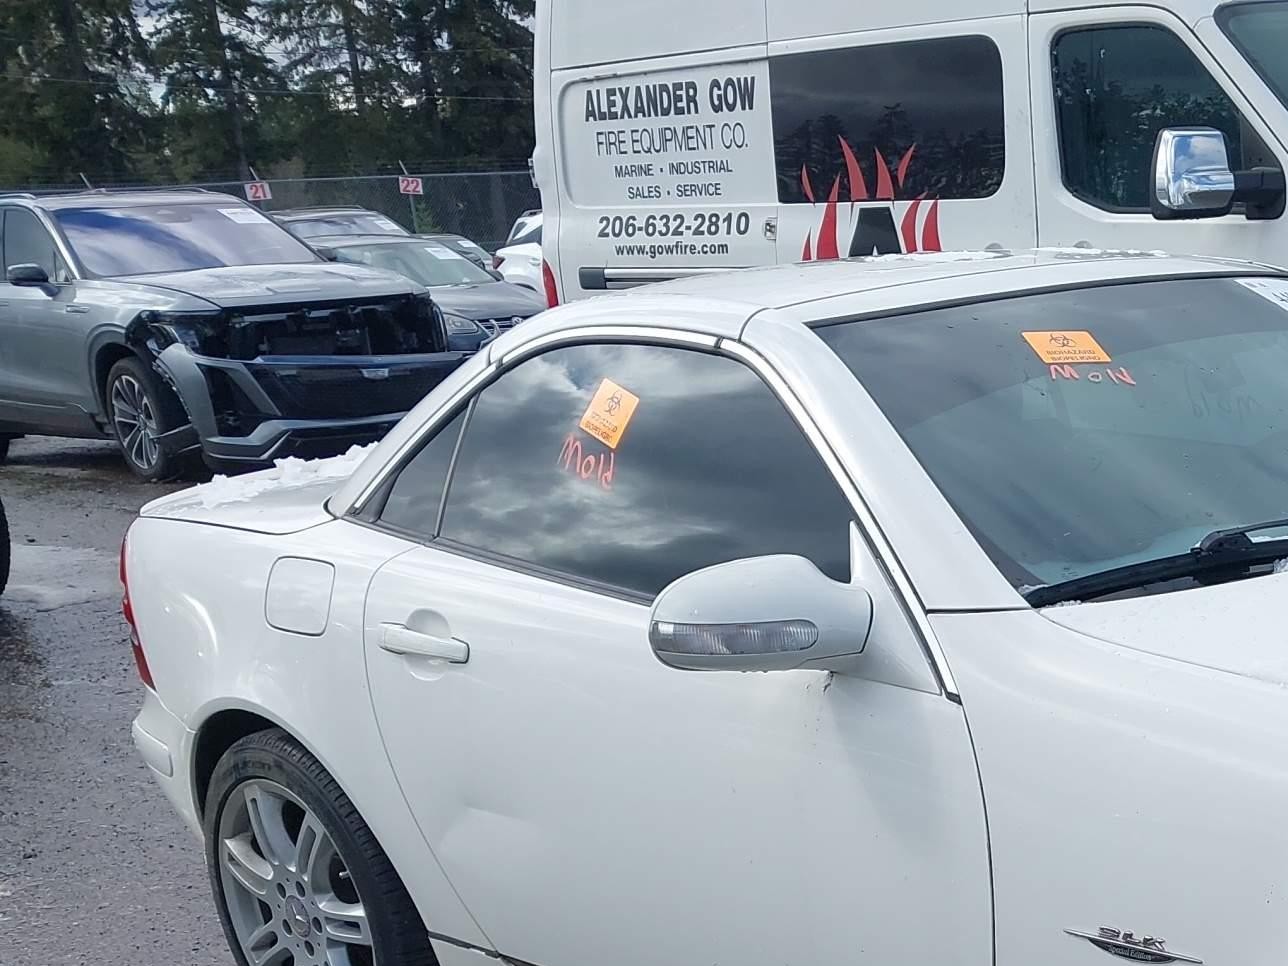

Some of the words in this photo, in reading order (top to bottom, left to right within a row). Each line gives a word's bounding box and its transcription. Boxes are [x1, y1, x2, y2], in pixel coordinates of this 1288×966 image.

[585, 81, 699, 122] ALEXANDER
[709, 76, 755, 113] GOW
[596, 129, 628, 156] FIRE
[630, 124, 715, 154] EQUIPMENT
[720, 122, 748, 149] CO.
[614, 164, 654, 178] MARINE
[668, 160, 733, 175] INDUSTRIAL
[249, 184, 268, 200] 21
[400, 178, 420, 194] 22
[627, 185, 661, 200] SALES
[676, 182, 722, 197] SERVICE
[598, 212, 750, 238] 206-632-2810
[615, 240, 729, 259] www.gowfire.com
